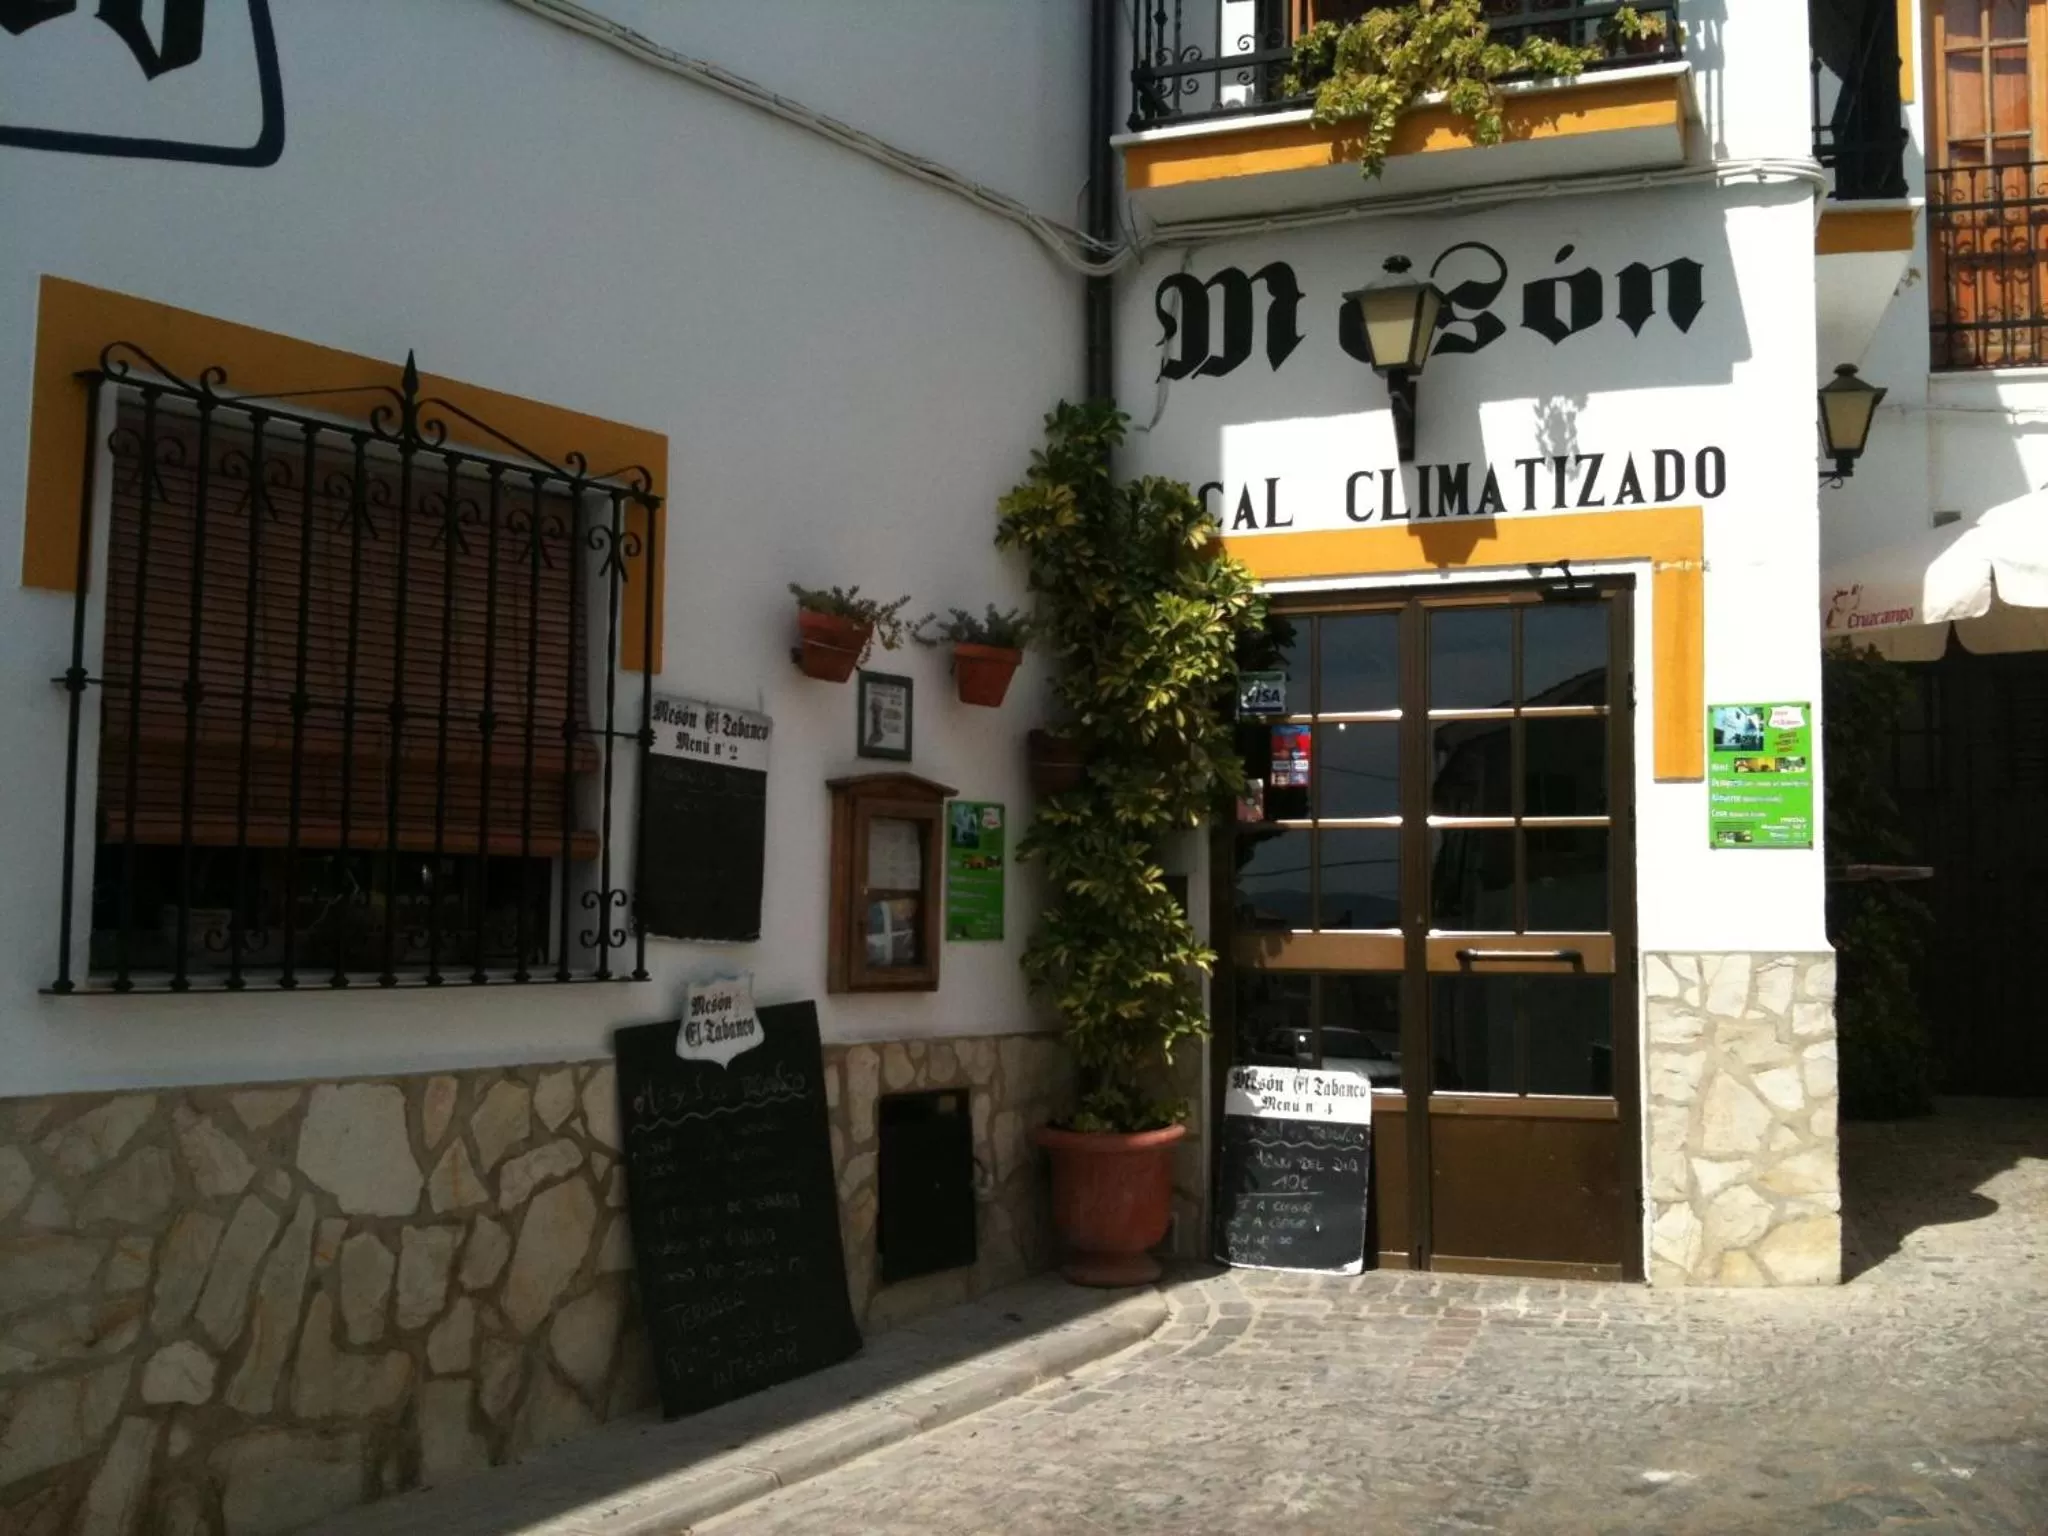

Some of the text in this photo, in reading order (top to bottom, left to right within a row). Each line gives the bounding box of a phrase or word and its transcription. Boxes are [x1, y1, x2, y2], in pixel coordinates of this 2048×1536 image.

[1198, 445, 1727, 531] CAL CLIMATIZADO
[1847, 607, 1914, 629] Cruzcampo
[652, 699, 697, 729] Mesón
[705, 709, 720, 735] El
[691, 992, 733, 1017] Mesón
[685, 1015, 756, 1047] El Tabanco
[1232, 1069, 1366, 1098] Mesón El Tabanco
